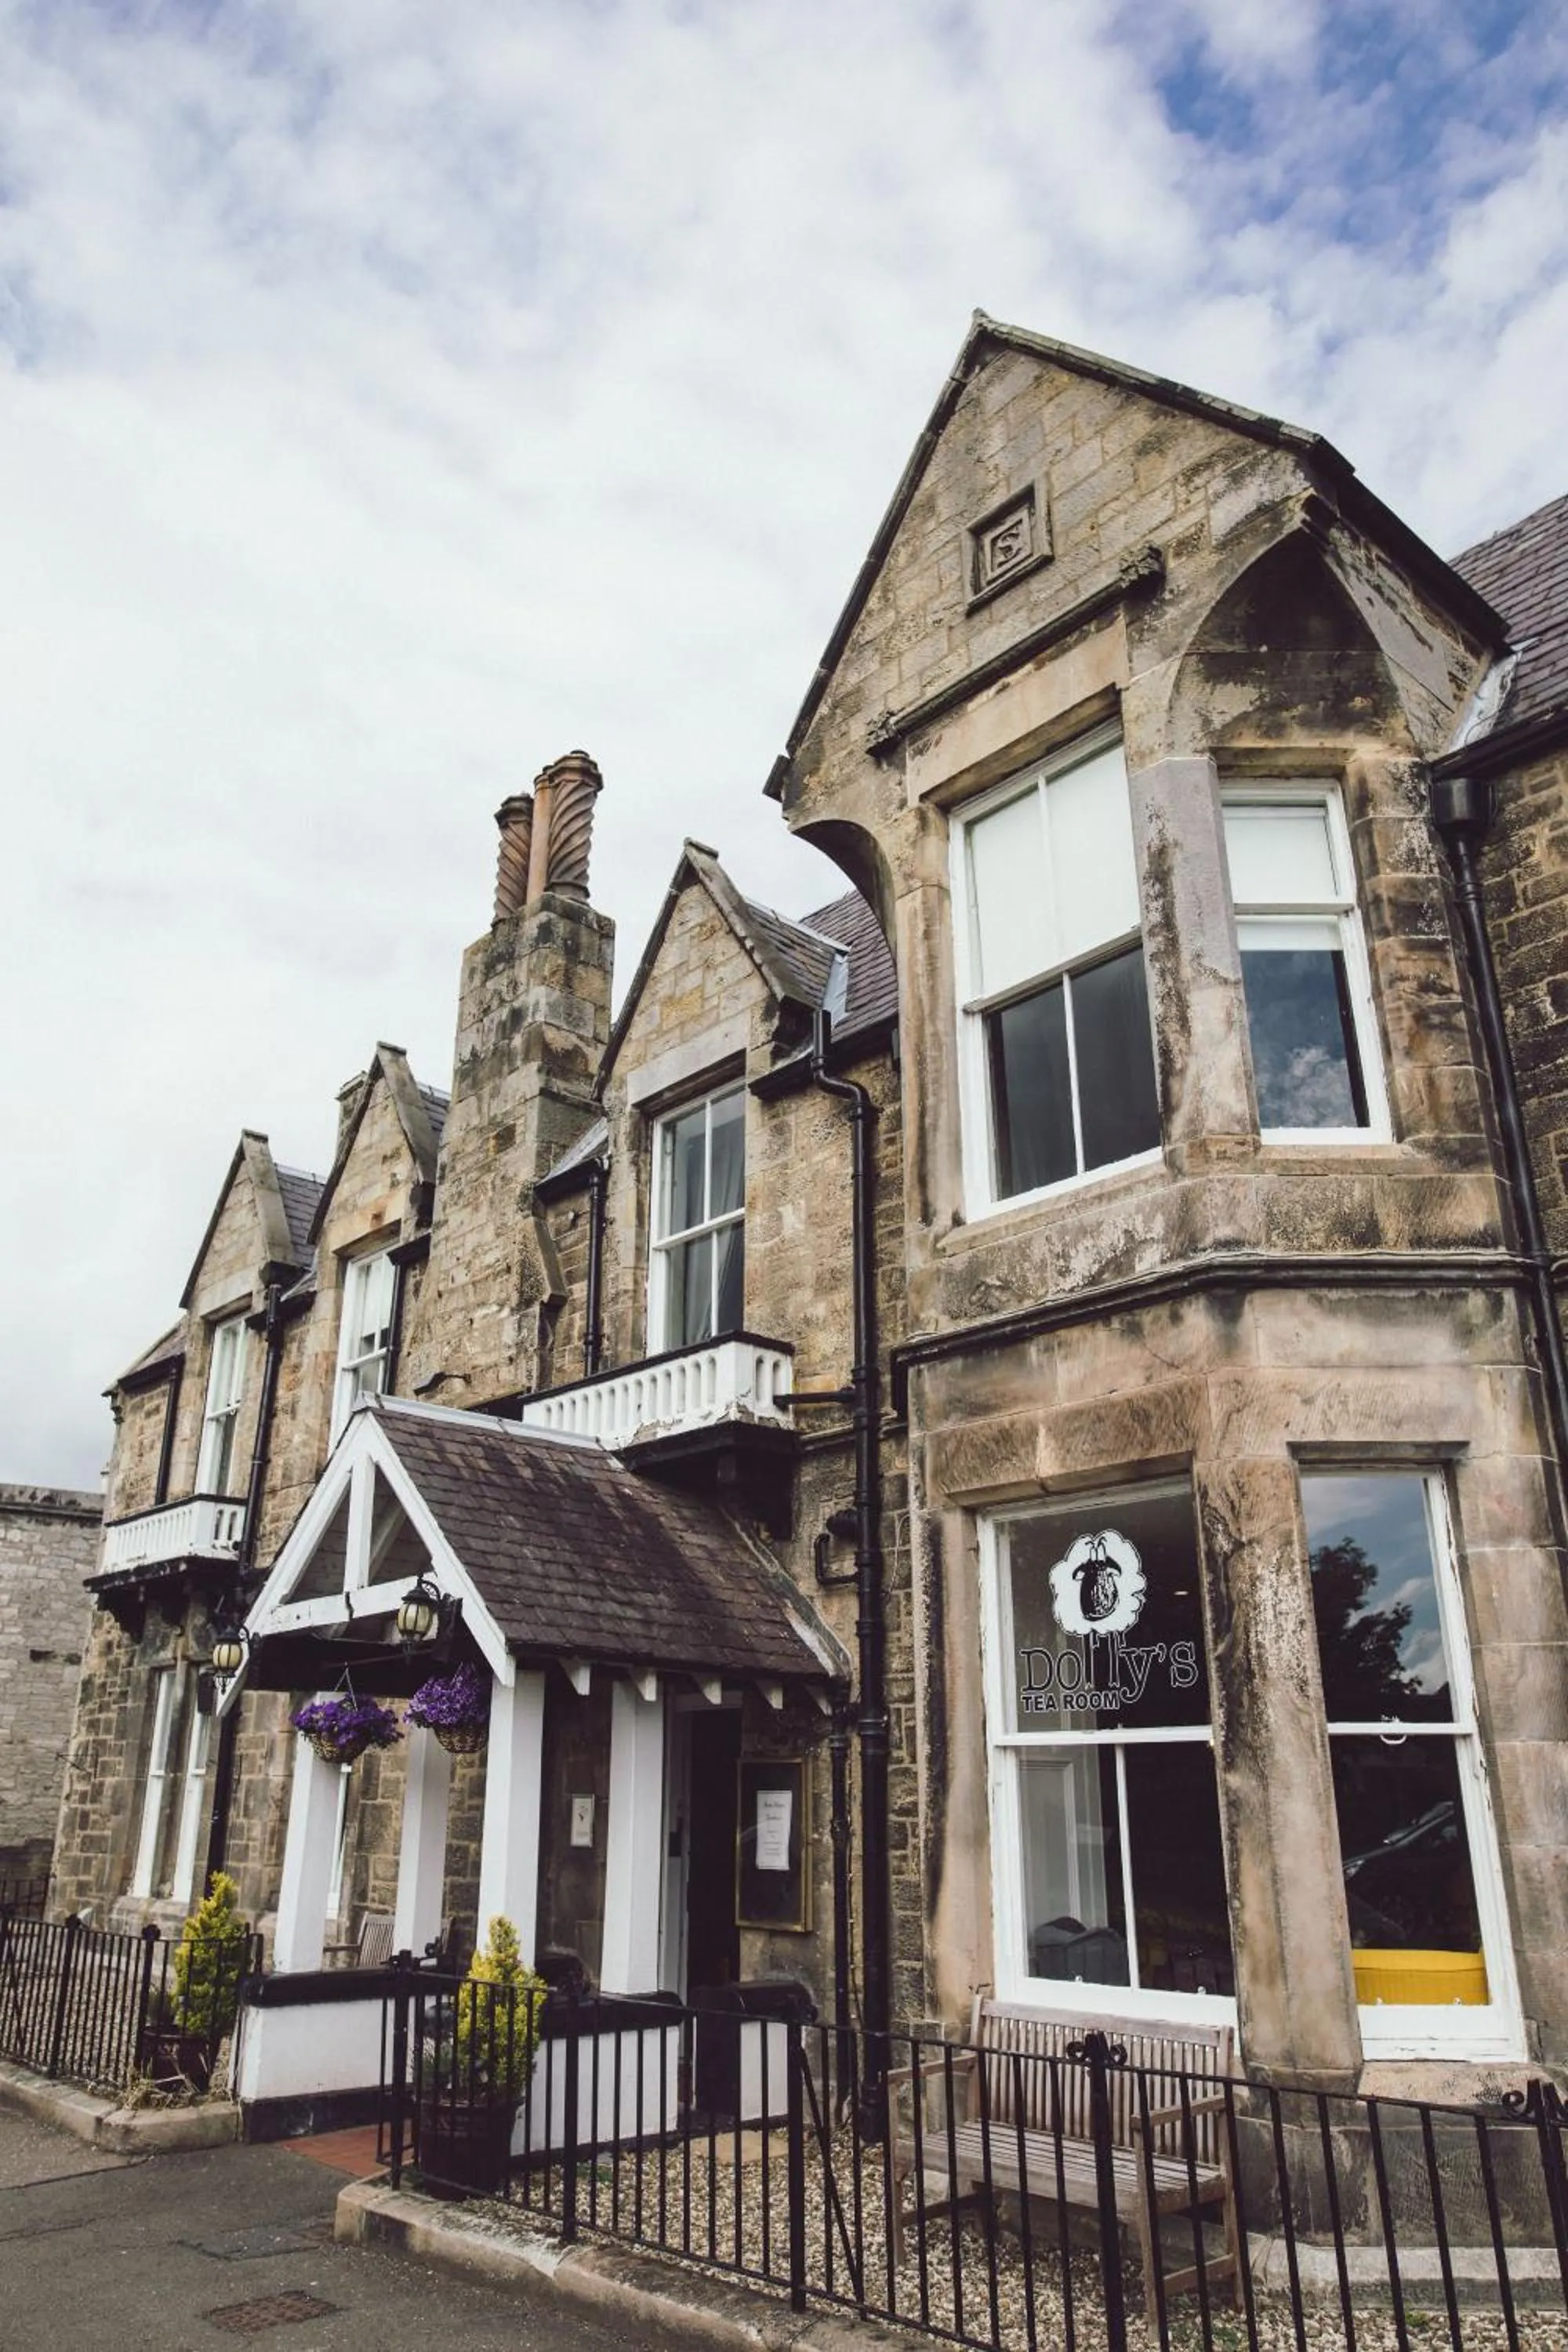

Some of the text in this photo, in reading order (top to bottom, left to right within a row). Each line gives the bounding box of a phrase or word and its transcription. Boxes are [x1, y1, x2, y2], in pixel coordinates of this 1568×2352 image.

[1020, 1631, 1198, 1703] Dolly's
[1021, 1691, 1120, 1712] TEA ROOM
